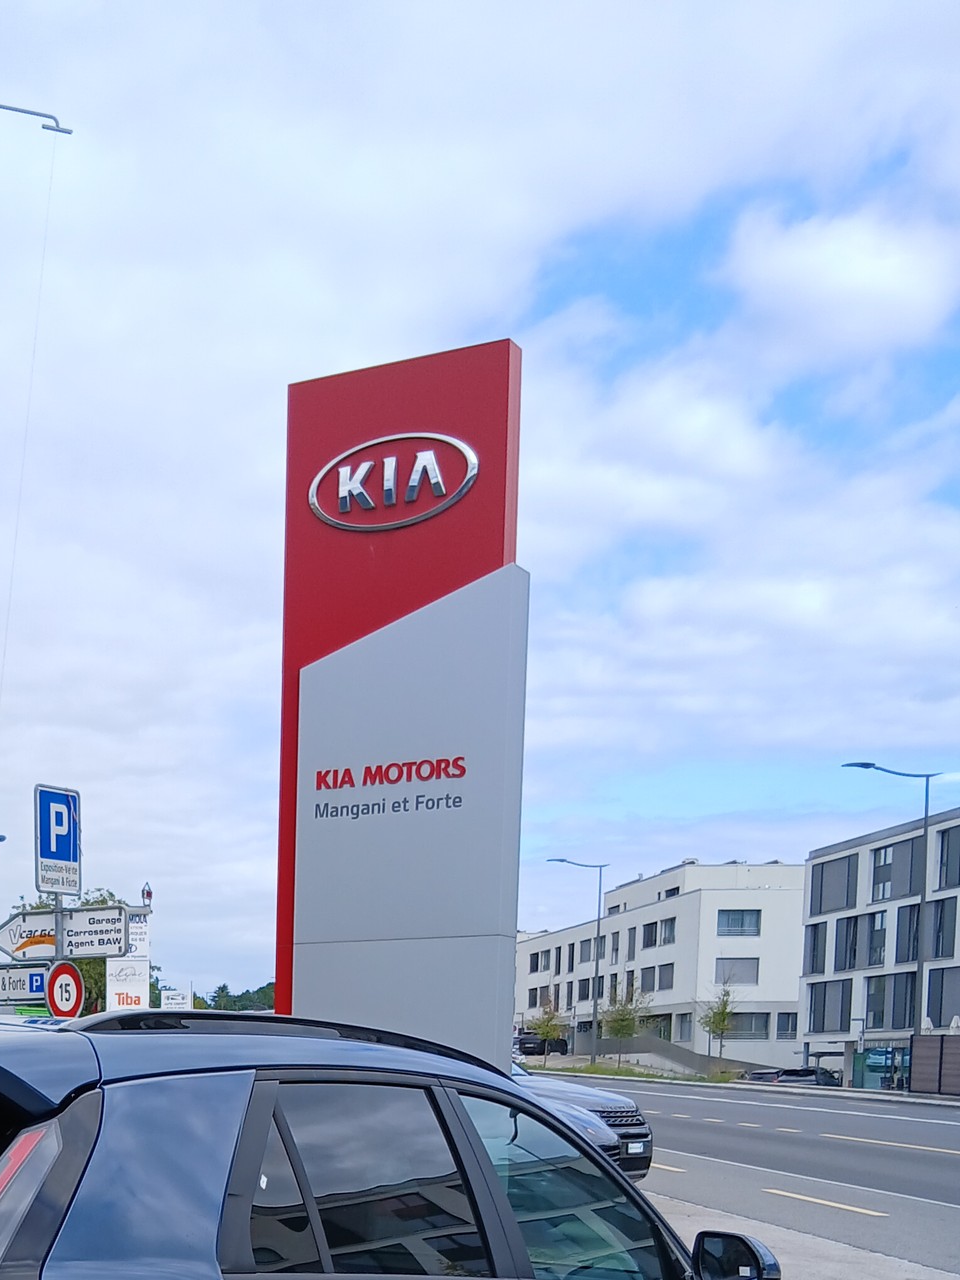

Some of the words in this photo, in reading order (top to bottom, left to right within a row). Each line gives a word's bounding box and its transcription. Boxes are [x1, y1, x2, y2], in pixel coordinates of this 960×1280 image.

[338, 450, 446, 513] KIA
[315, 768, 355, 791] KIA
[362, 756, 467, 787] MOTORS
[314, 798, 386, 820] Mangani
[391, 797, 410, 813] et
[415, 793, 463, 811] Forte
[49, 802, 69, 853] P
[88, 917, 122, 925] Garage
[66, 926, 122, 938] Carrosserie
[66, 940, 95, 949] Agent
[97, 937, 122, 946] BAW
[0, 978, 7, 991] &
[8, 976, 26, 991] Forte
[32, 975, 41, 991] P
[58, 982, 71, 1002] 15
[114, 992, 141, 1006] Tiba
